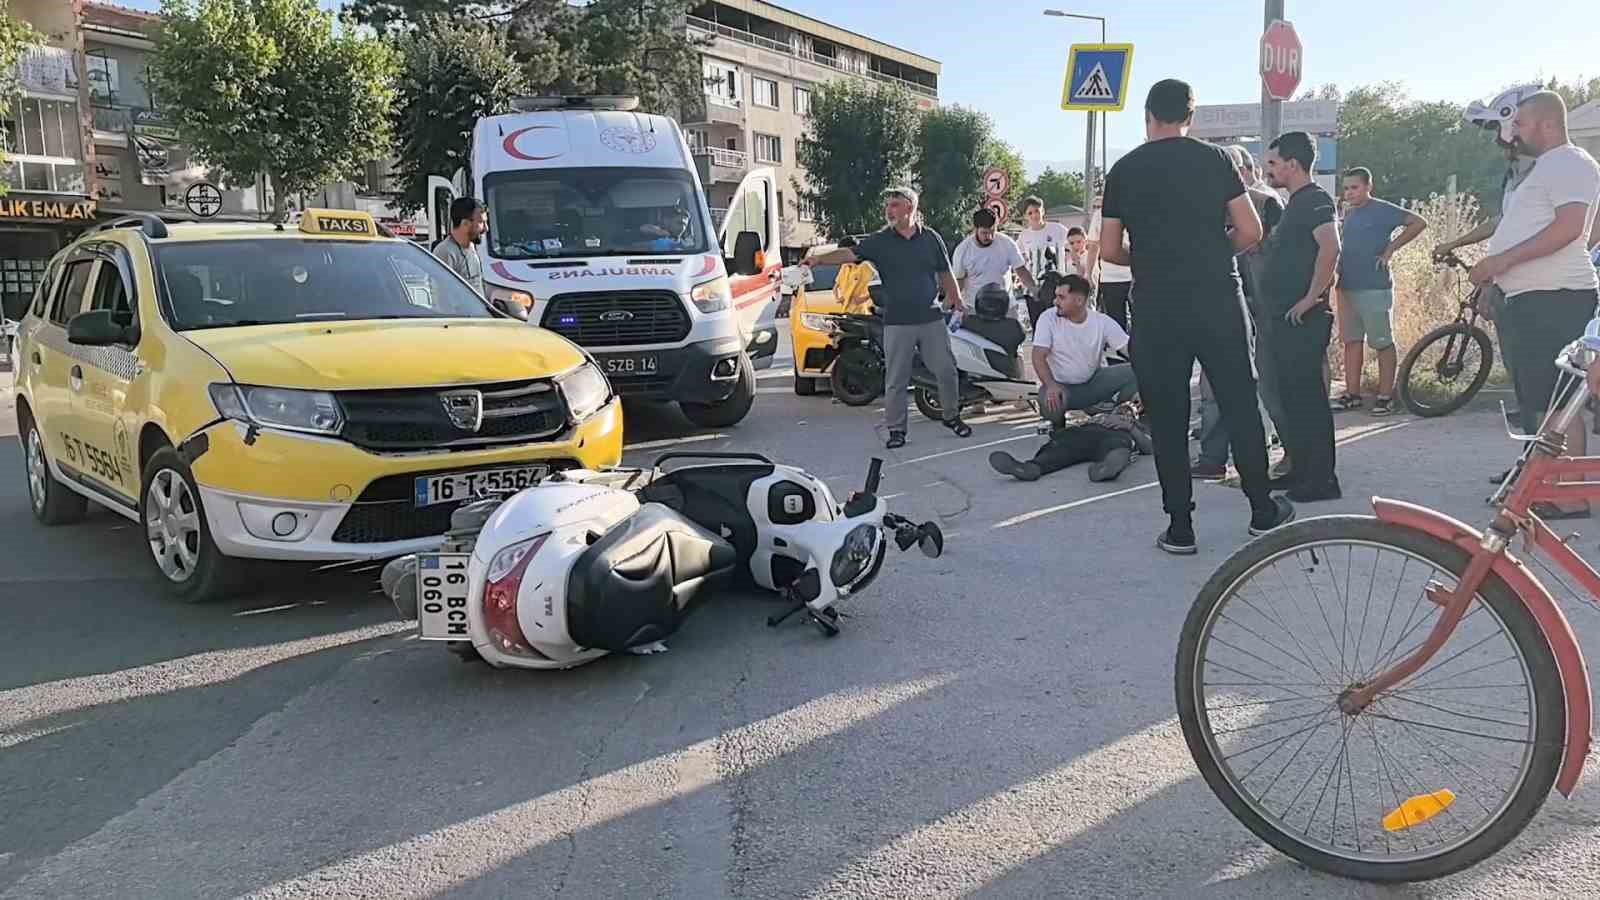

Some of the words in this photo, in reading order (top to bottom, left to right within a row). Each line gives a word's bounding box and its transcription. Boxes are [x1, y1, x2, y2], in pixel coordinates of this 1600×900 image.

[1264, 43, 1298, 77] DUR
[32, 200, 97, 219] EMLAK
[608, 359, 635, 372] SZB
[641, 357, 656, 371] 14
[431, 478, 455, 501] 16
[465, 474, 478, 497] T
[446, 562, 466, 584] 16
[423, 576, 442, 613] 060
[447, 597, 467, 634] BCM
